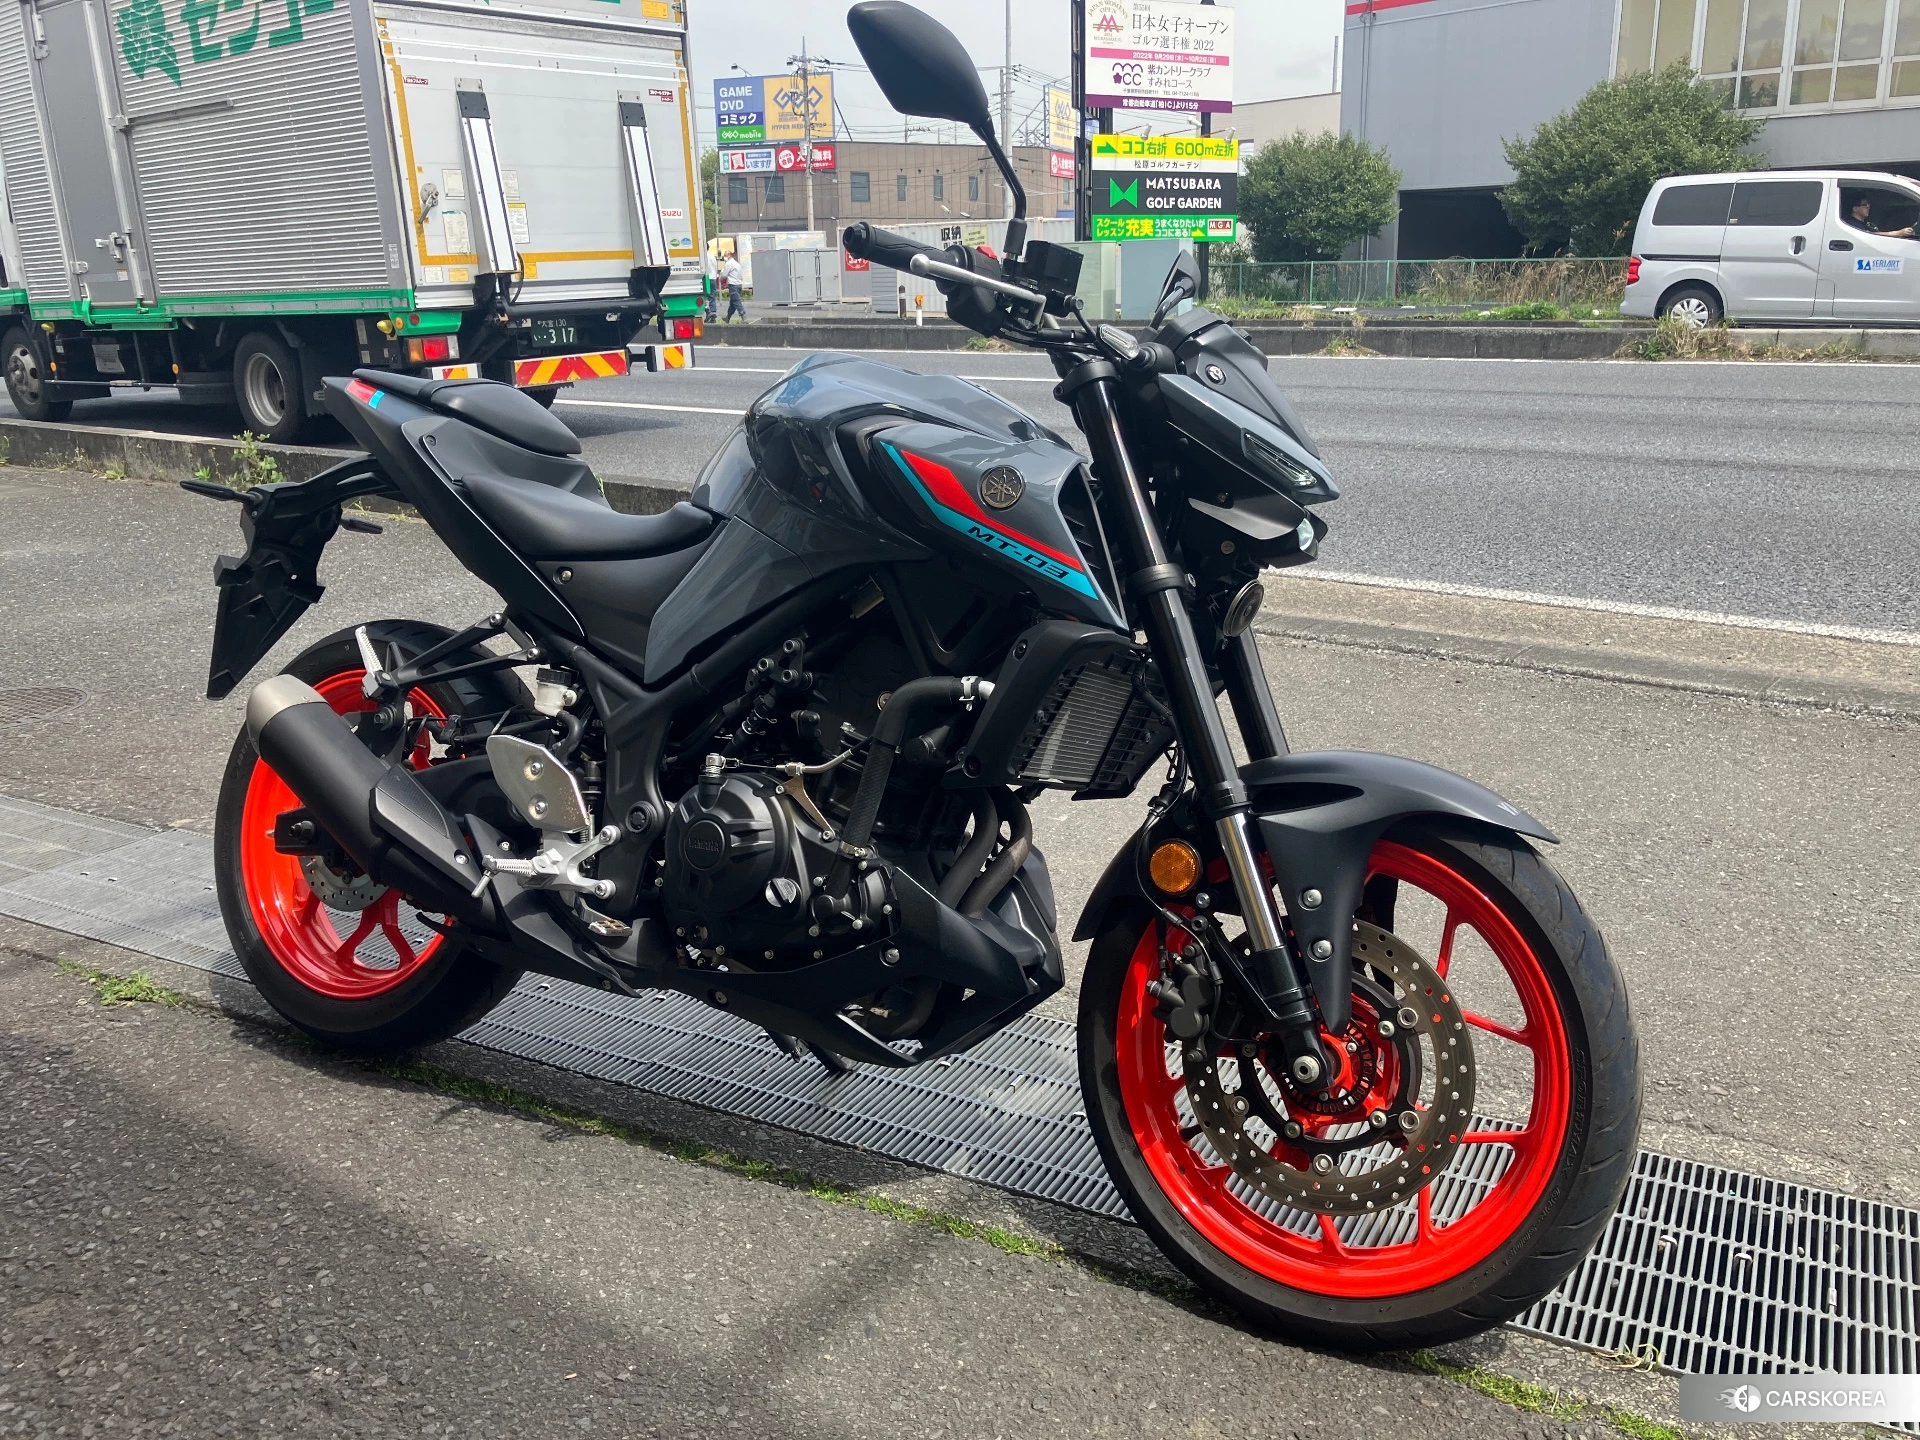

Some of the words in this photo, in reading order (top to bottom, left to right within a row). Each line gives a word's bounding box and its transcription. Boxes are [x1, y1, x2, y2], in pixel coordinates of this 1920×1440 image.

[1132, 13, 1229, 34] 日本女子オープン
[1132, 34, 1190, 50] ゴルフ選手権
[1193, 39, 1214, 51] 2022
[1147, 64, 1211, 77] 紫カントリークラブ
[1147, 77, 1193, 88] すみれコース
[719, 85, 752, 98] GAME
[720, 99, 744, 111] DVD
[720, 112, 757, 125] コミック
[740, 130, 761, 139] mobile
[1122, 140, 1167, 156] ココ右折
[1175, 142, 1233, 157] 600m左折
[1134, 160, 1200, 169] 松原ゴルフガーデン
[1146, 177, 1222, 190] MATSUBARA
[1146, 197, 1176, 209] GOLF
[1177, 197, 1222, 209] GARDEN
[1096, 218, 1126, 228] スクール
[1125, 218, 1154, 237] 充実
[1155, 218, 1206, 228] うまくなりたいが
[941, 225, 962, 241] 収納
[1096, 228, 1125, 237] レッスン
[967, 525, 1070, 579] MT-03
